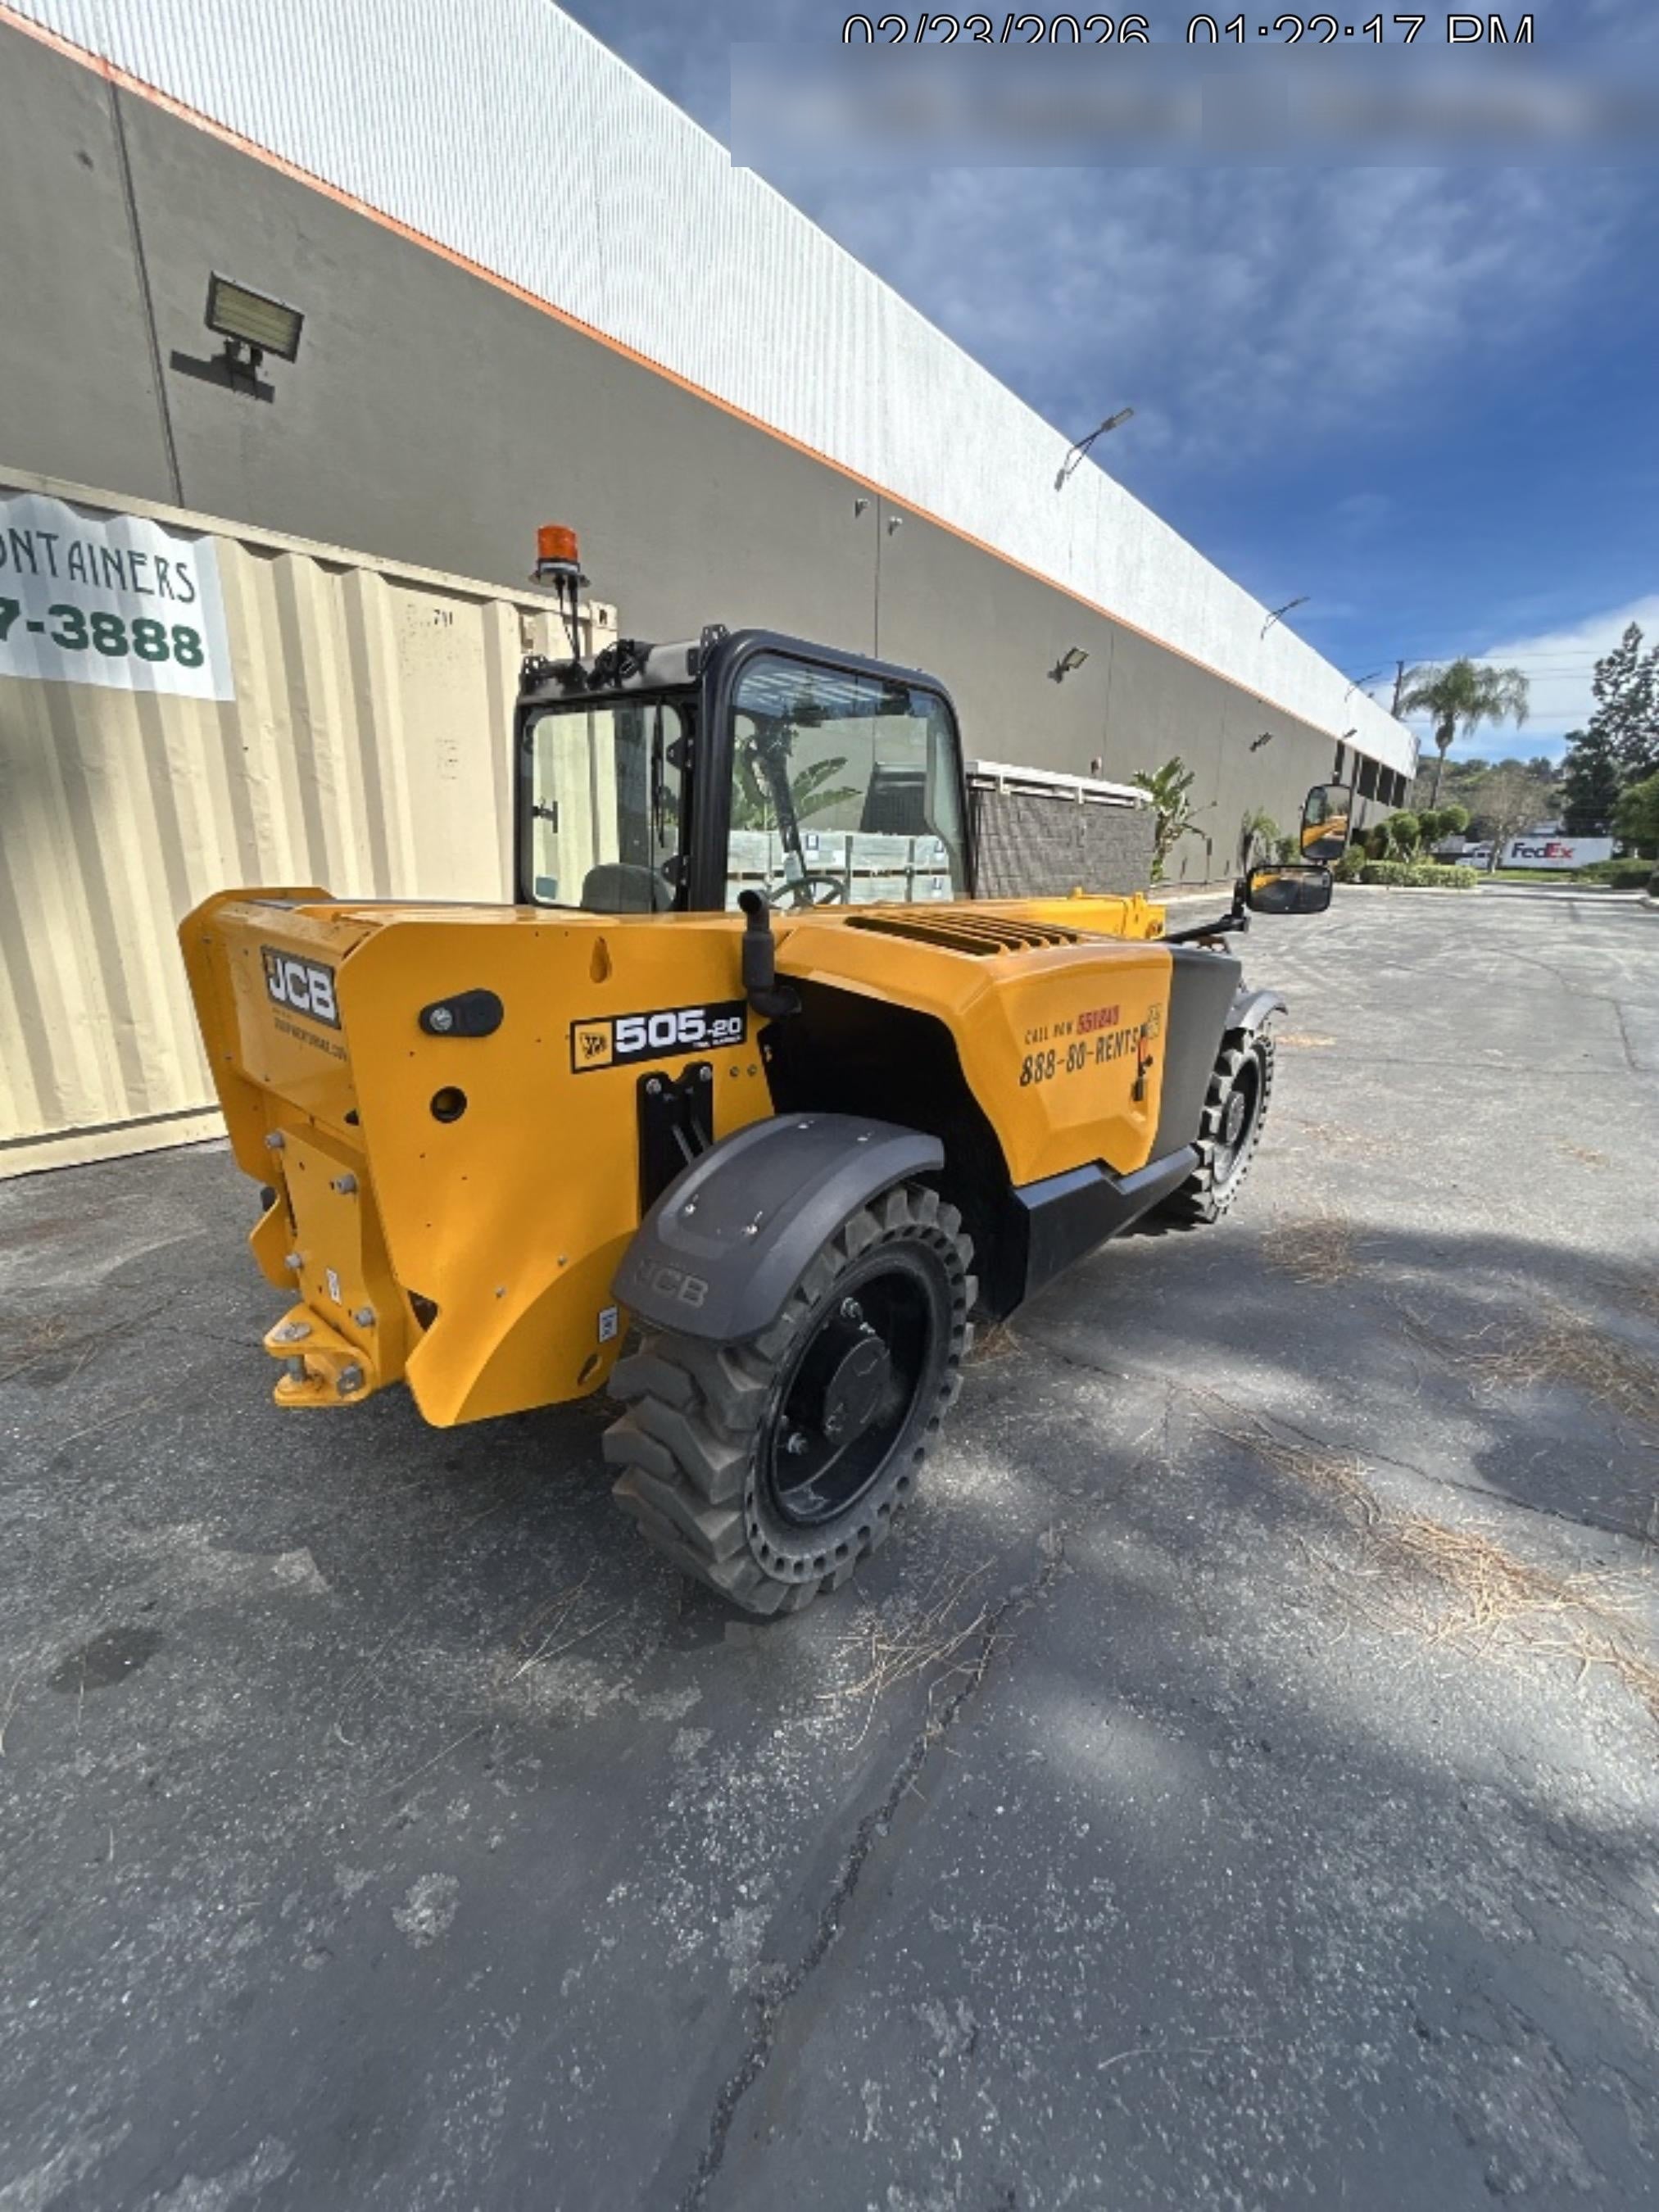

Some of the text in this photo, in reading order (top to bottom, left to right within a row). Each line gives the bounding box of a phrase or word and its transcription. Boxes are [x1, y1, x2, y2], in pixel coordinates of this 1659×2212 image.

[1512, 842, 1574, 859] FedEx
[269, 958, 336, 1021] JCB
[633, 1258, 709, 1308] JCB
